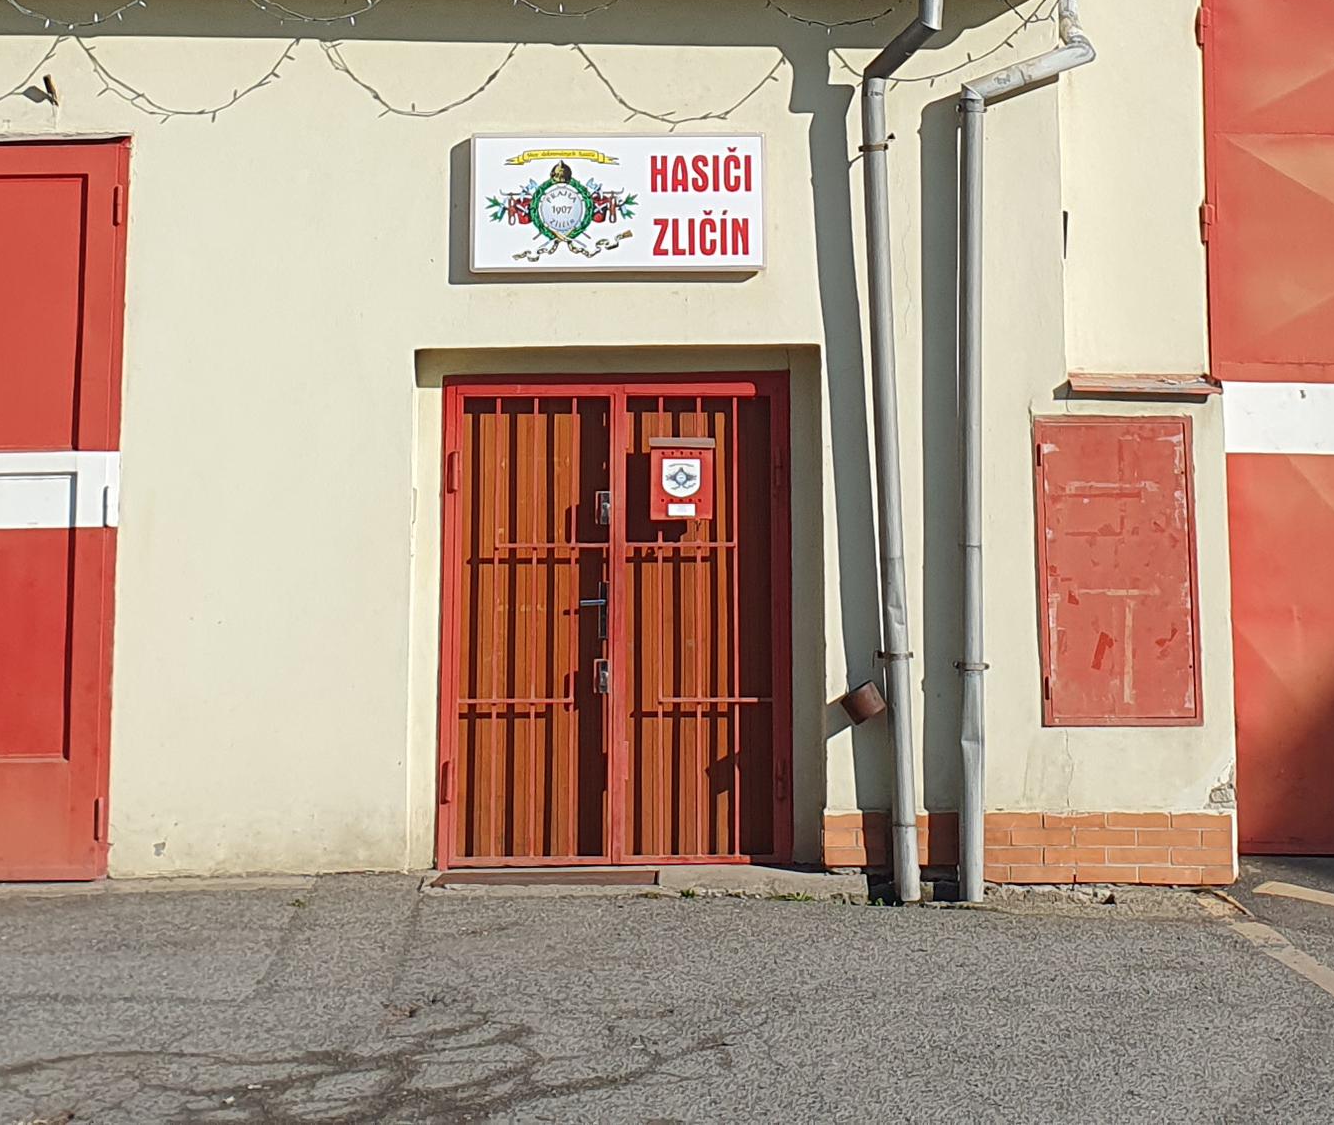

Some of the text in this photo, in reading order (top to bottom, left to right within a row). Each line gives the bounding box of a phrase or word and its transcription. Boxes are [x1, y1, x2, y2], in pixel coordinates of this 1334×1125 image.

[650, 146, 752, 192] HASIČI
[552, 205, 572, 215] 1907
[652, 209, 750, 256] ZLIČÍN
